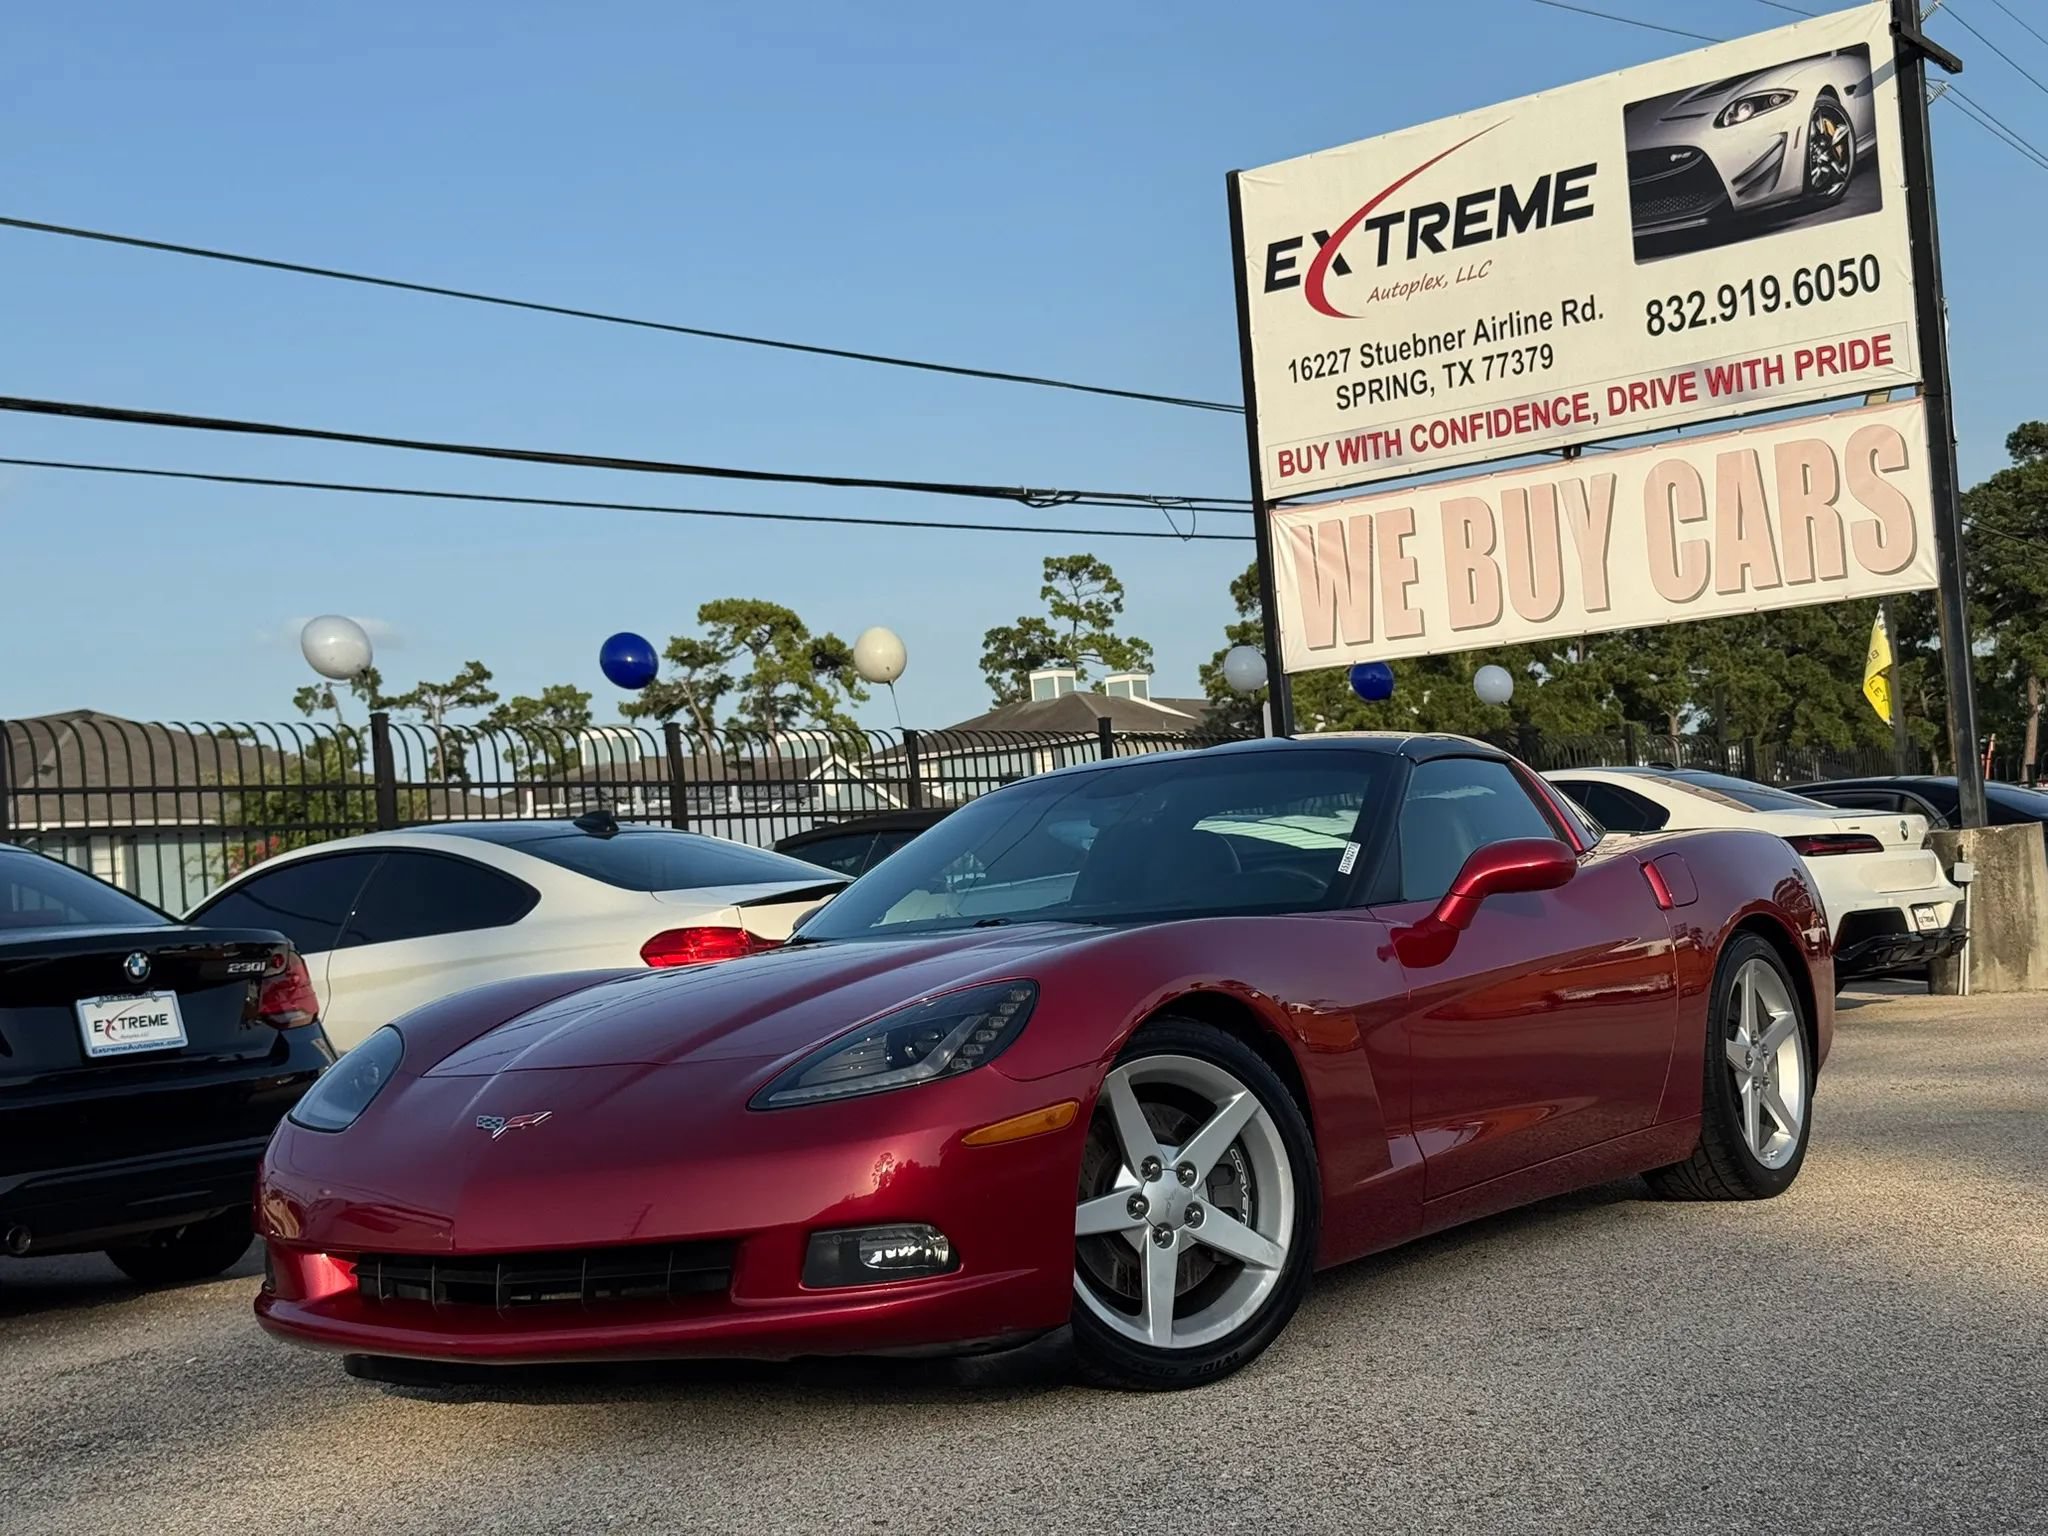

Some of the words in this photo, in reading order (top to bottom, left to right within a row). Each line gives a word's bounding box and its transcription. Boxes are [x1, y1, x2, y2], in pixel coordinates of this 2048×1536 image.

[1264, 162, 1598, 294] EXTREME
[1367, 273, 1448, 303] Autoplex,
[1456, 259, 1493, 284] LLC
[1646, 254, 1881, 337] 832.919.6050
[1288, 348, 1351, 383] 16227
[1360, 328, 1466, 369] Stuebner
[1474, 310, 1553, 346] Airline
[1562, 294, 1604, 327] Rd.
[1337, 369, 1436, 410] SPRING,
[1442, 359, 1475, 389] TX
[1482, 343, 1554, 382] 77379
[1278, 442, 1330, 477] BUY
[1336, 428, 1402, 466] WITH
[1410, 392, 1600, 452] CONFIDENCE,
[1607, 371, 1698, 416] DRIVE
[1704, 354, 1785, 397] WITH
[1794, 333, 1894, 380] PRIDE
[1290, 507, 1425, 651] WE
[1441, 473, 1617, 632] BUY
[1643, 424, 1917, 604] CARS
[93, 1013, 170, 1033] EXTREME
